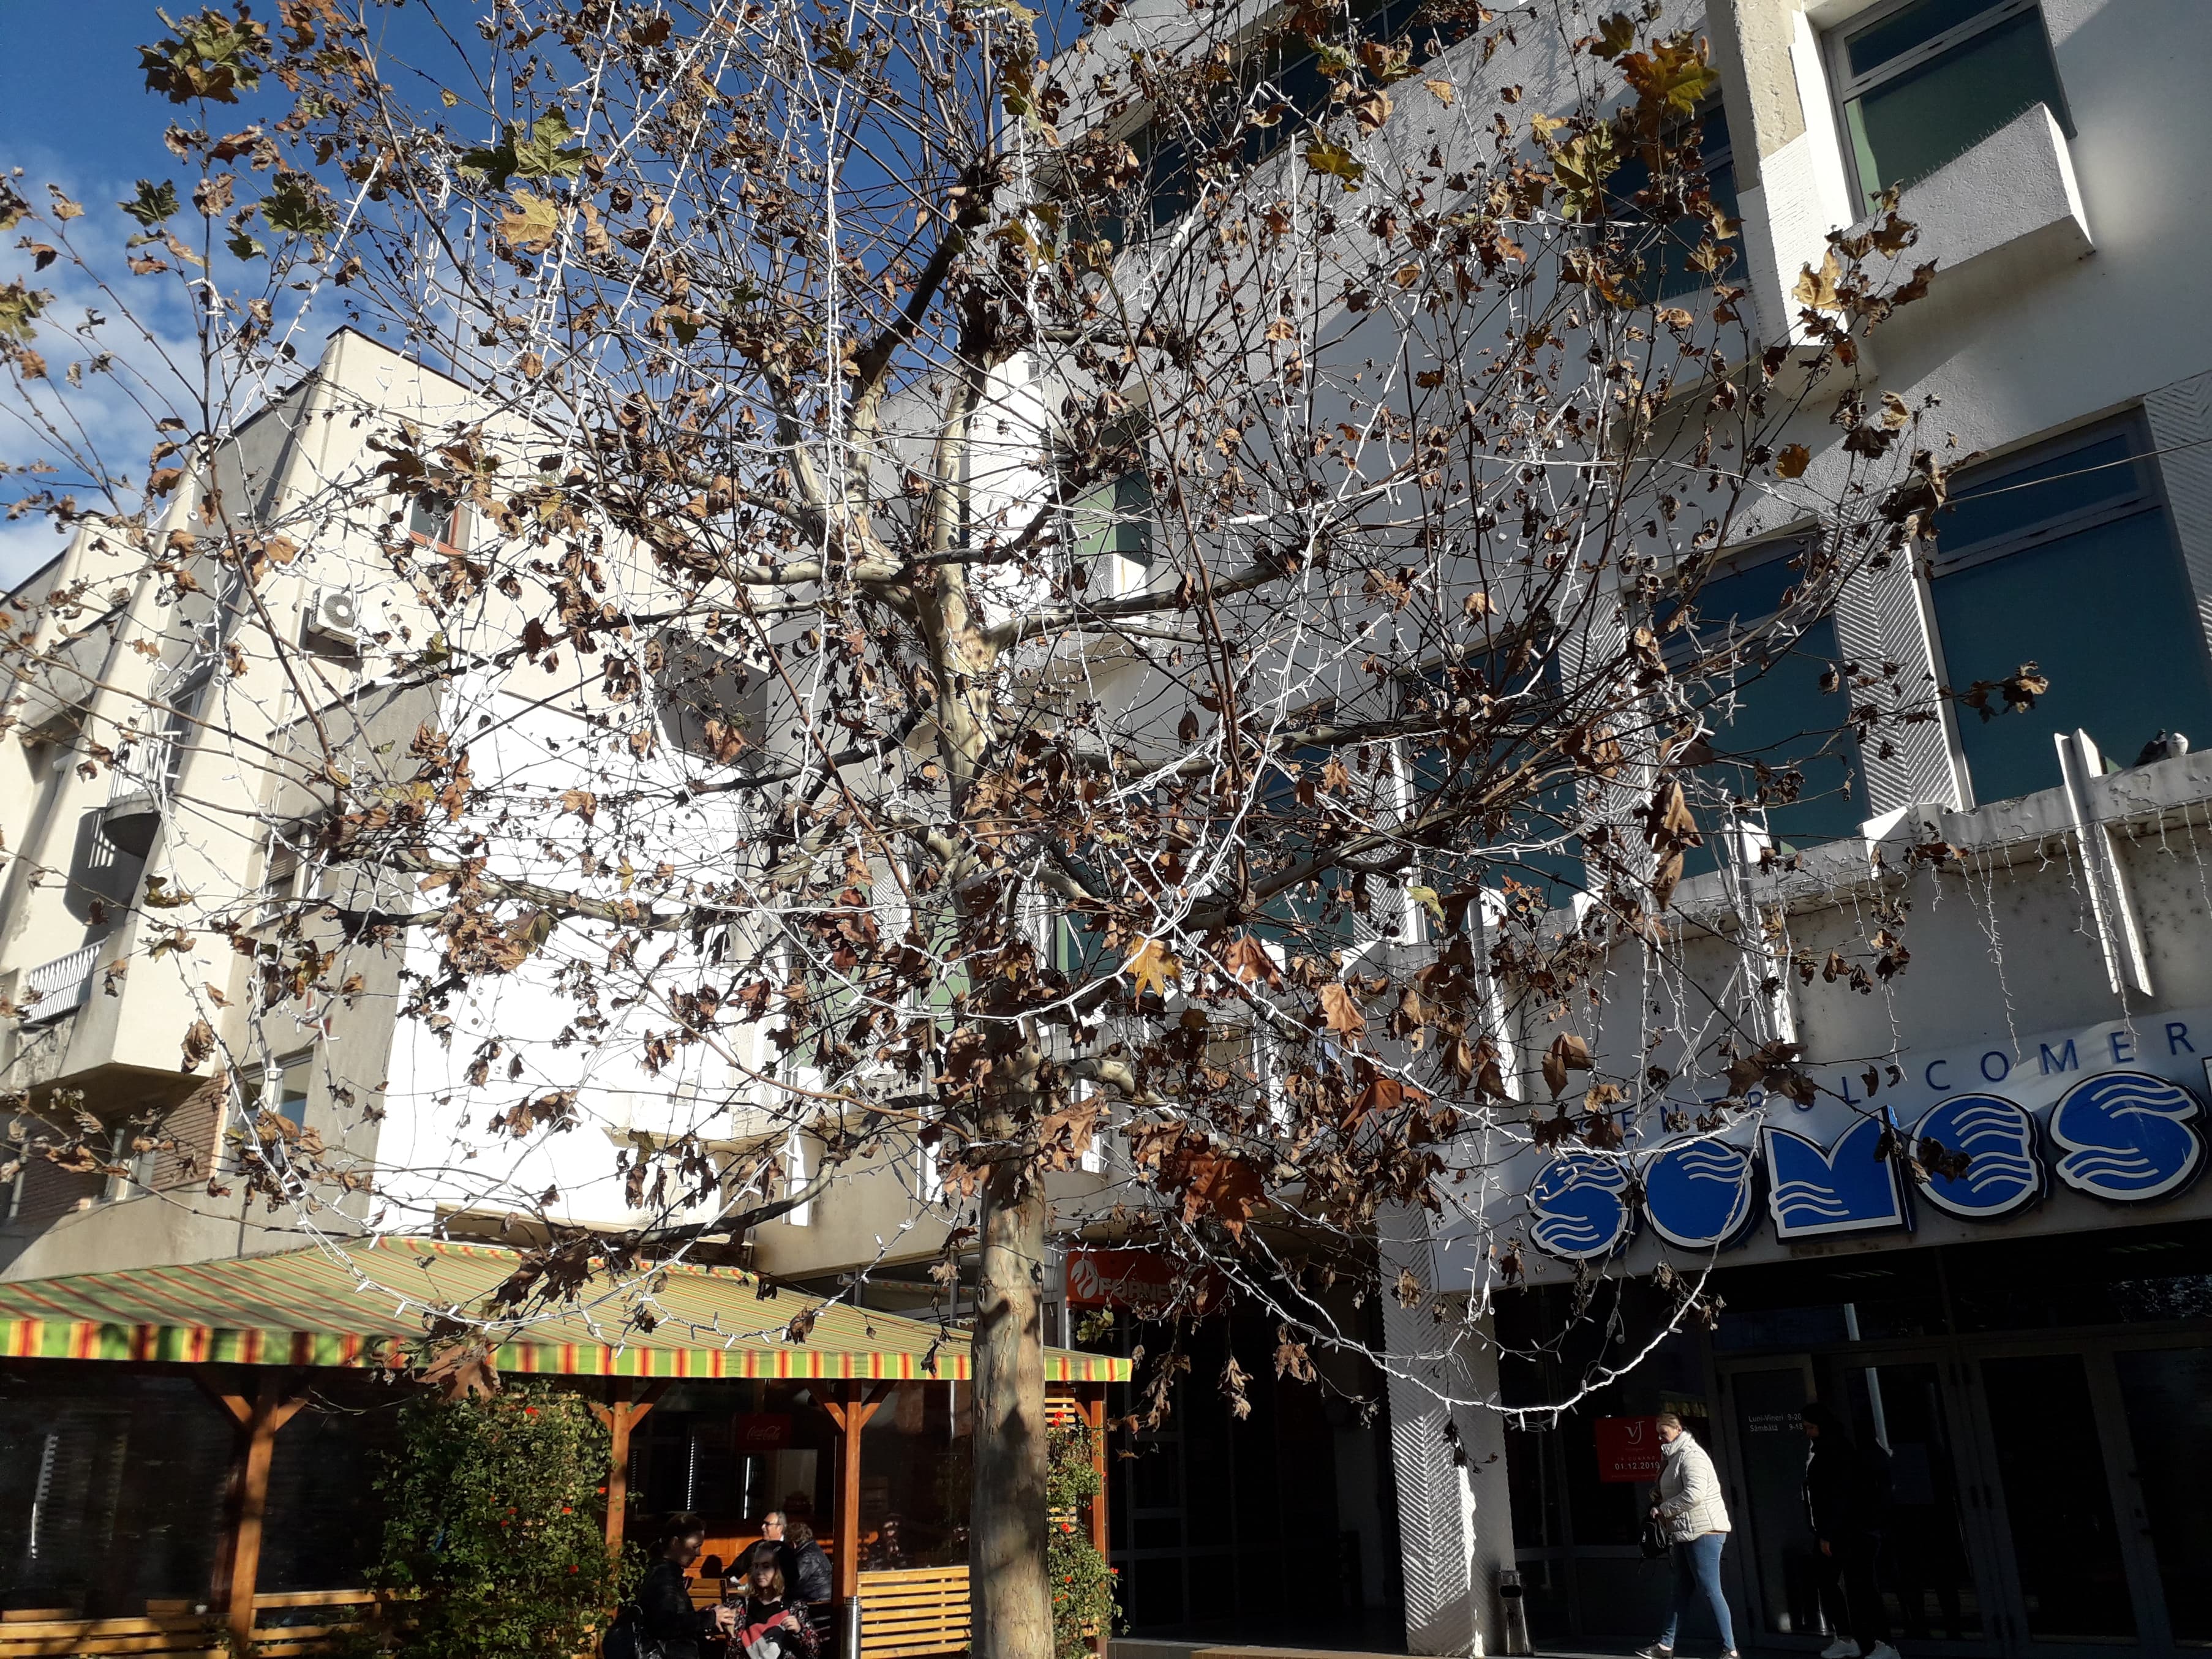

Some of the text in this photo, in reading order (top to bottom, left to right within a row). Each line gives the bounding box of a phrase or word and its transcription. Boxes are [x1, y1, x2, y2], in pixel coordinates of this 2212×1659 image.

[1925, 1022, 2195, 1090] COMER
[747, 1425, 781, 1441] Coca-Cola
[1614, 1461, 1661, 1470] 01.12.2019
